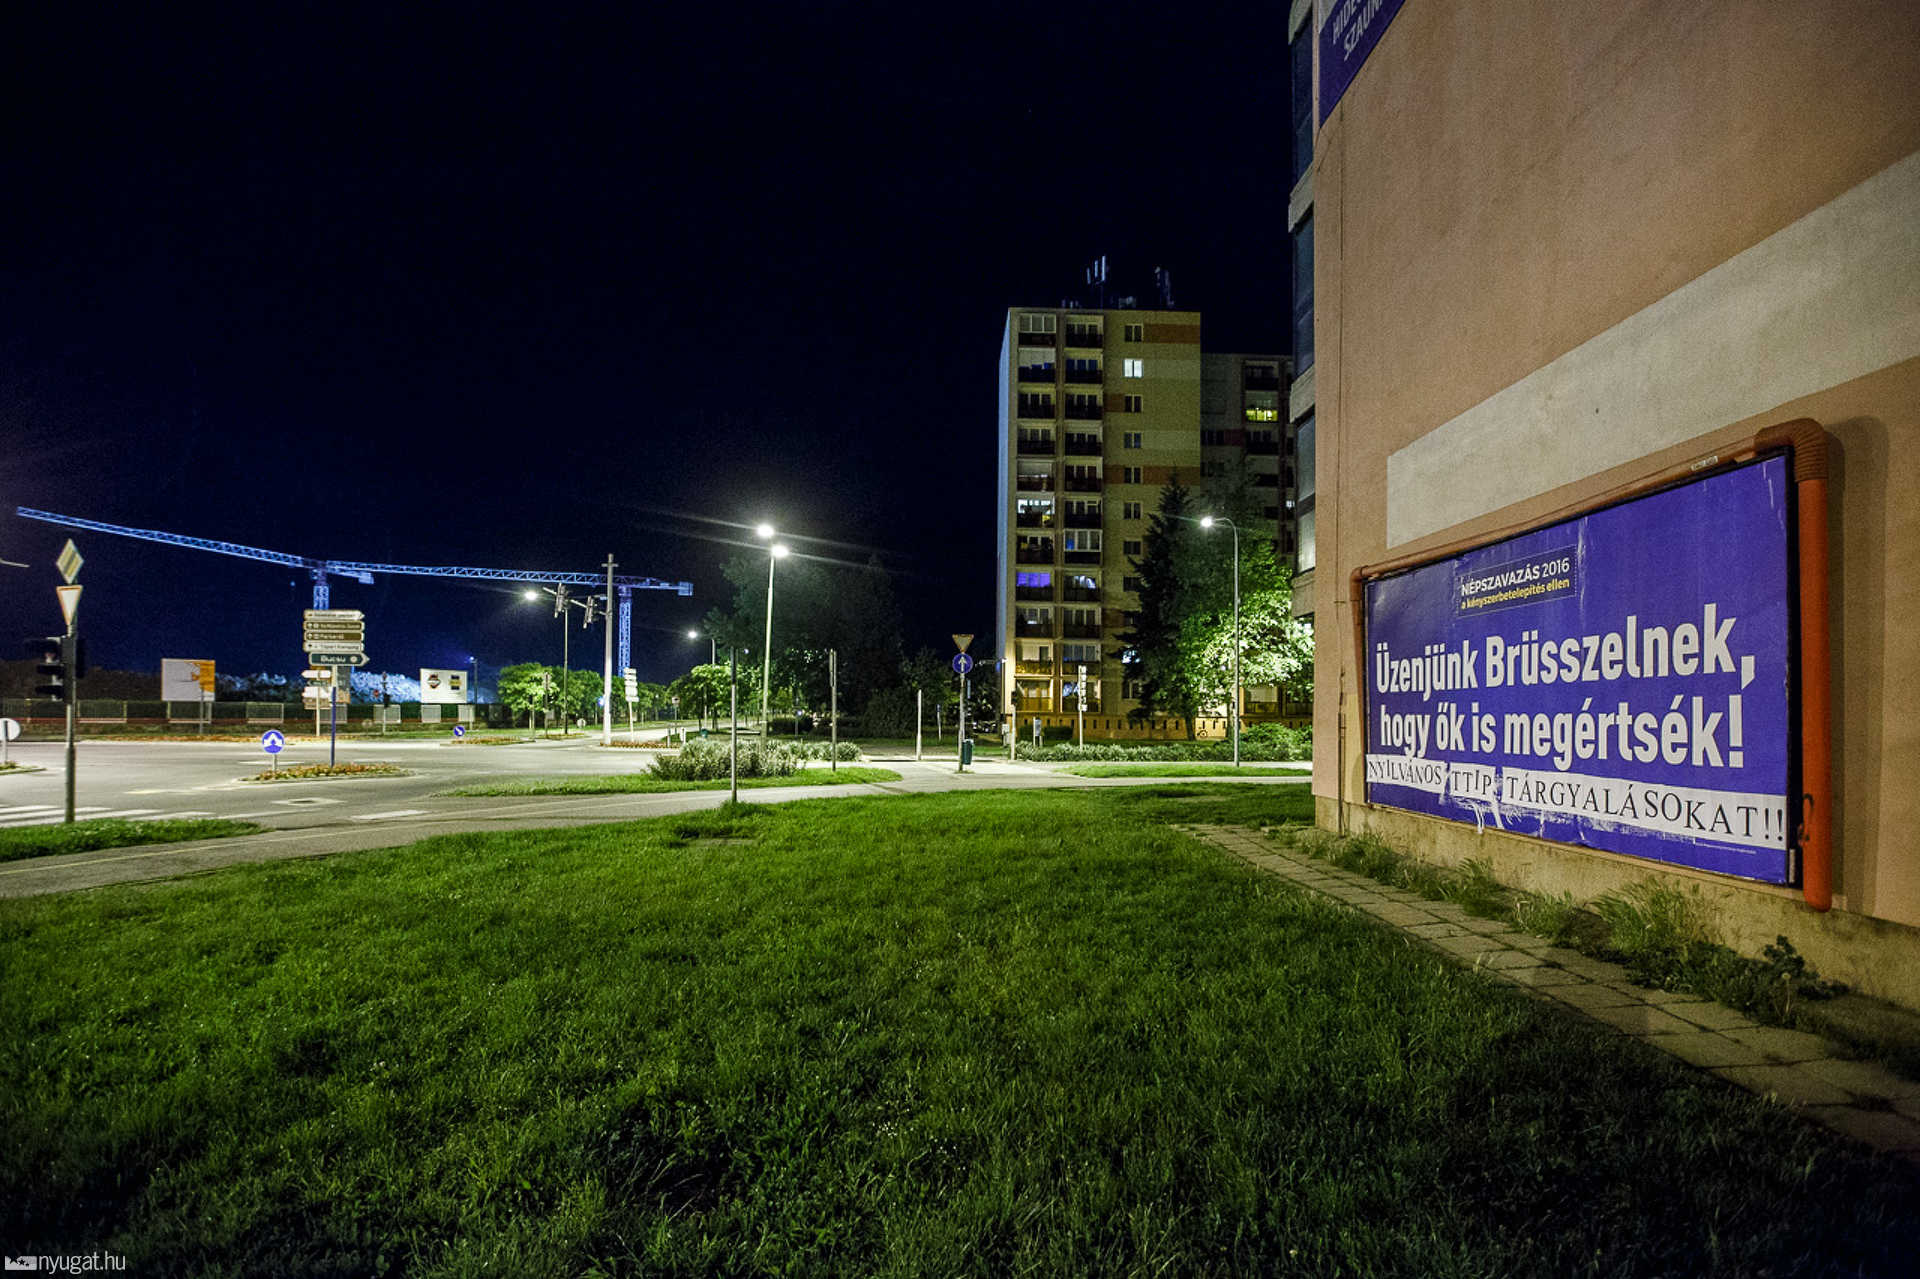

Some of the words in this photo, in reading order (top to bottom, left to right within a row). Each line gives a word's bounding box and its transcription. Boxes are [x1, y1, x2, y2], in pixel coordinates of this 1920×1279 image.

[1332, 0, 1361, 45] HIDE
[1343, 0, 1382, 61] SZAUN
[1461, 563, 1541, 597] NÉPSZAVAZÁS
[1541, 557, 1570, 578] 2016
[1461, 600, 1467, 609] a
[1546, 577, 1570, 592] ellen
[1376, 641, 1479, 702] Üzenjünk
[1486, 602, 1756, 691] Brüsszelnek,
[1380, 704, 1431, 759] hogy
[1436, 701, 1465, 752] ők
[1471, 701, 1497, 754] is
[1504, 694, 1744, 772] megértsék!
[1506, 772, 1784, 842] TÁRGYALÁSOKAT!!
